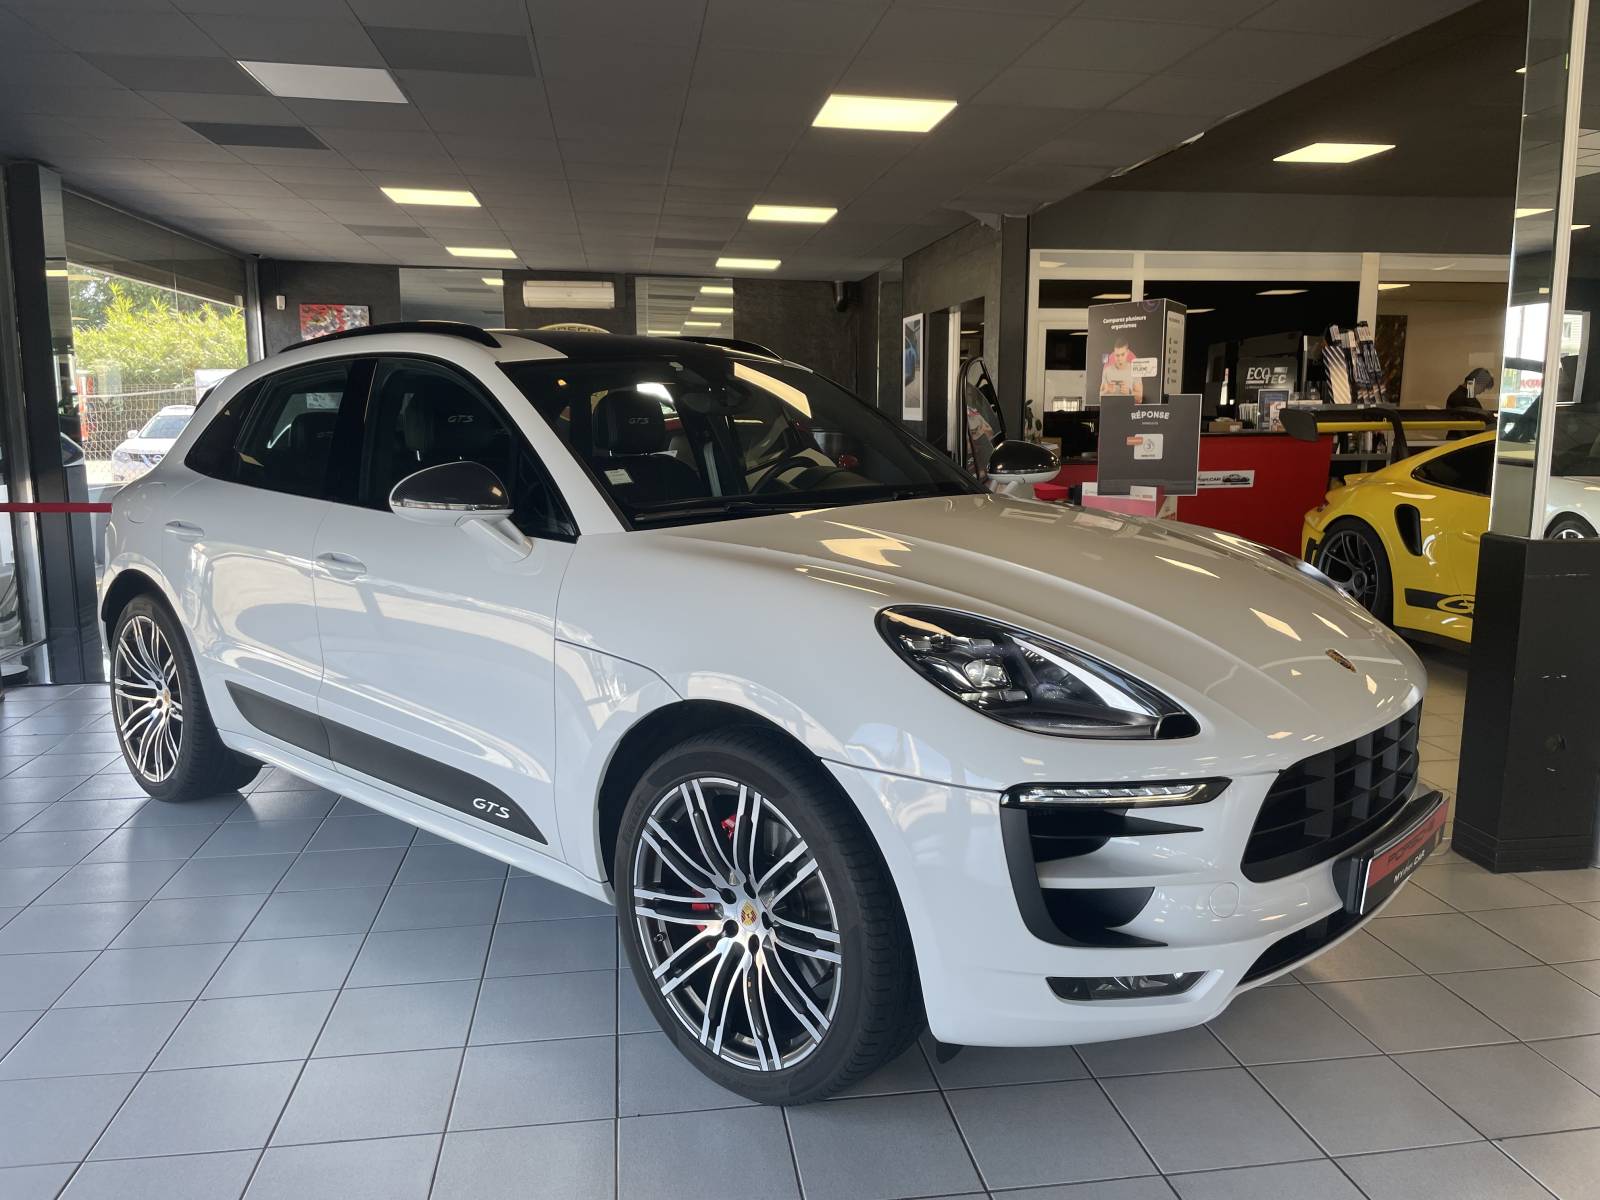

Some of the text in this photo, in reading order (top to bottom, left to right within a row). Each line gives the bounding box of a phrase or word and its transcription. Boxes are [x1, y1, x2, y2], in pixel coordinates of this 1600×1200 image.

[1125, 315, 1147, 323] plusieurs
[1246, 366, 1271, 380] ECO
[1264, 374, 1287, 384] TEC
[448, 414, 475, 423] GTS
[1130, 409, 1170, 421] RÉPONSE
[628, 417, 649, 425] GTS
[472, 797, 511, 819] GTS
